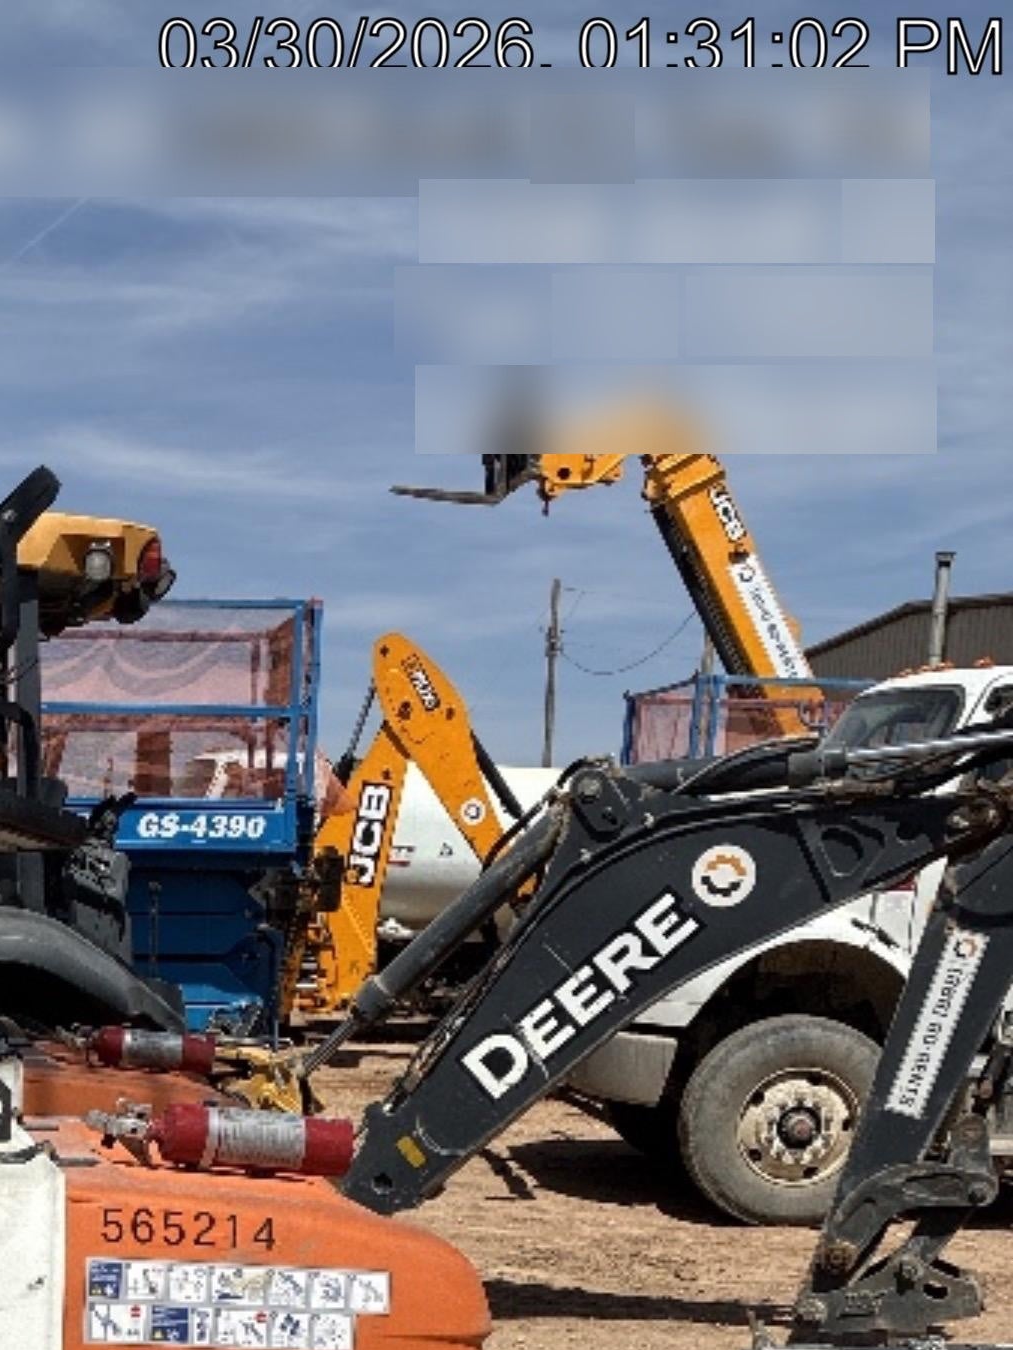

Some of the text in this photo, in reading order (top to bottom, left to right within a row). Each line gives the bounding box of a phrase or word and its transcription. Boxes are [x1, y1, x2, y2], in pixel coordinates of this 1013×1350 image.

[137, 812, 267, 839] GS-4390
[349, 784, 390, 884] JCB
[461, 893, 699, 1099] DEERE
[100, 1208, 276, 1251] 565214
